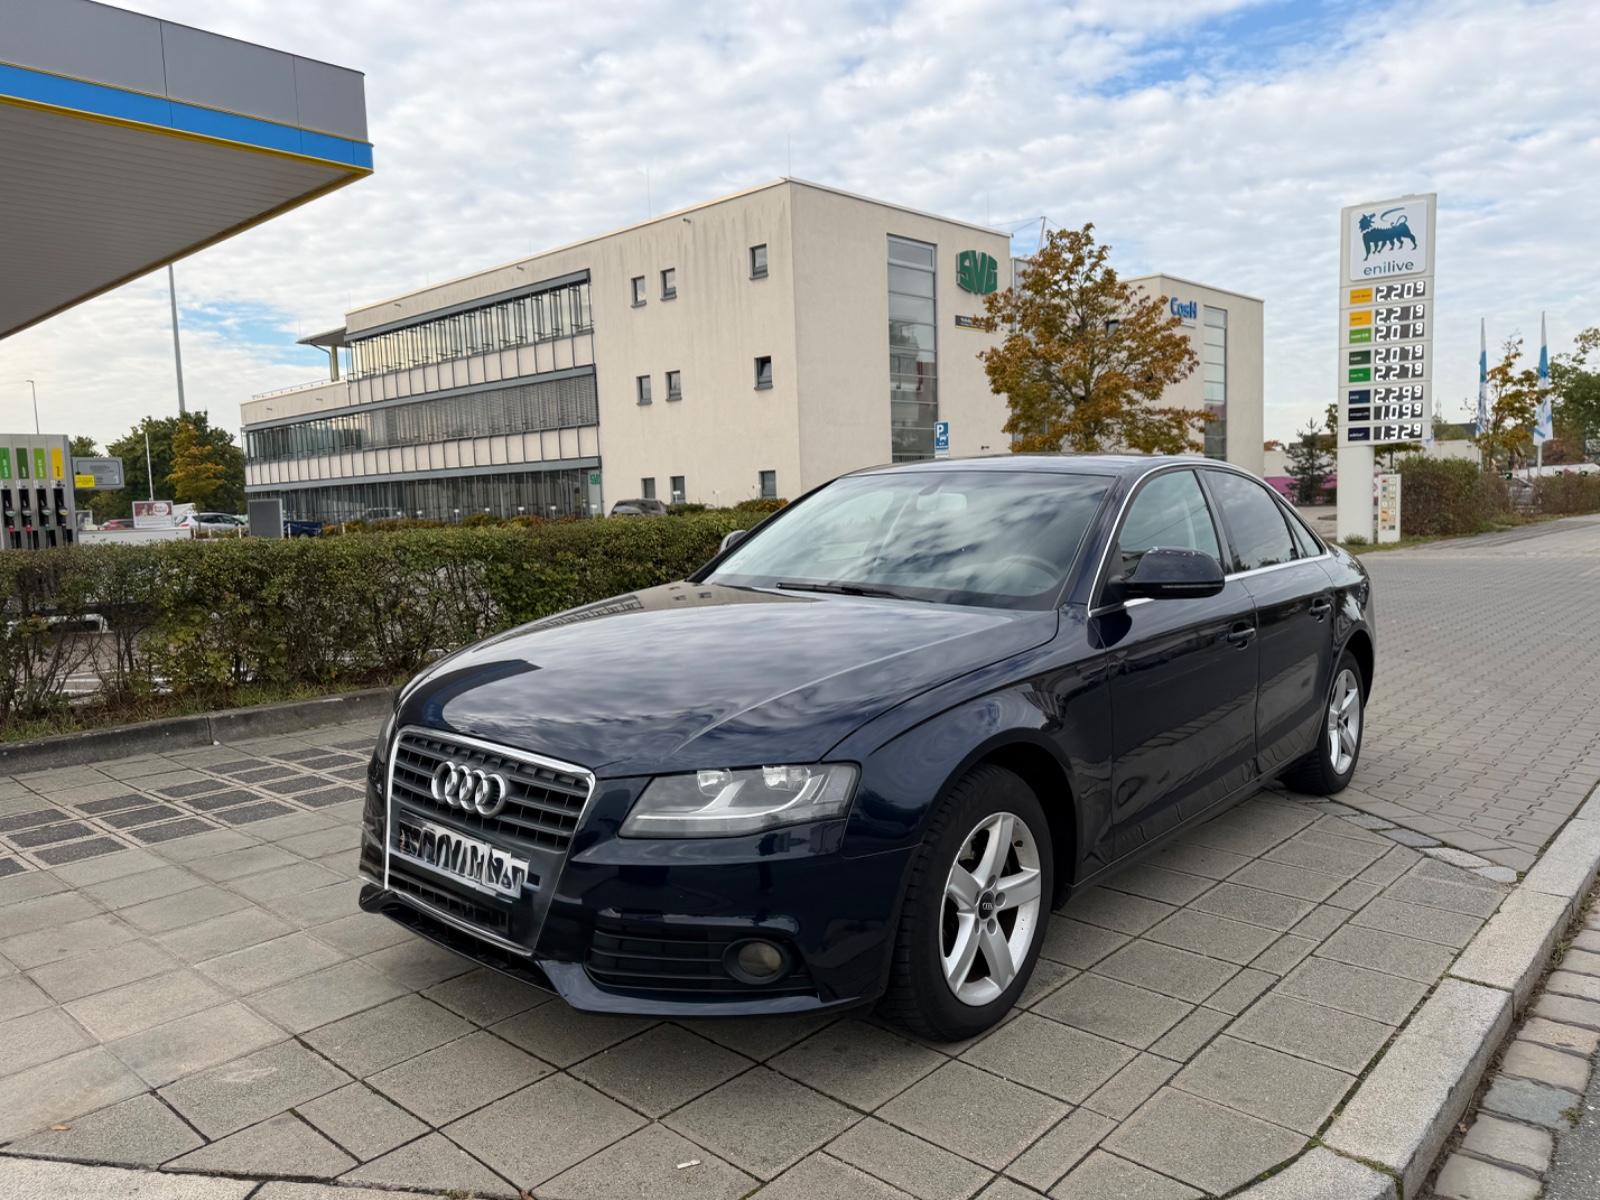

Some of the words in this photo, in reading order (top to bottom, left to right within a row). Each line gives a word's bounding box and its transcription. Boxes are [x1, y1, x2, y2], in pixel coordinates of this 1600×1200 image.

[957, 250, 997, 294] SVG
[1363, 261, 1414, 276] enilive
[1376, 281, 1425, 302] 2.209
[1376, 304, 1424, 325] 2.219
[1376, 322, 1423, 342] 2.019
[1375, 344, 1423, 364] 2.079
[1375, 362, 1422, 381] 2.279
[1375, 385, 1422, 403] 2.299
[1381, 403, 1422, 420] 1.099
[1380, 423, 1422, 440] 1.329
